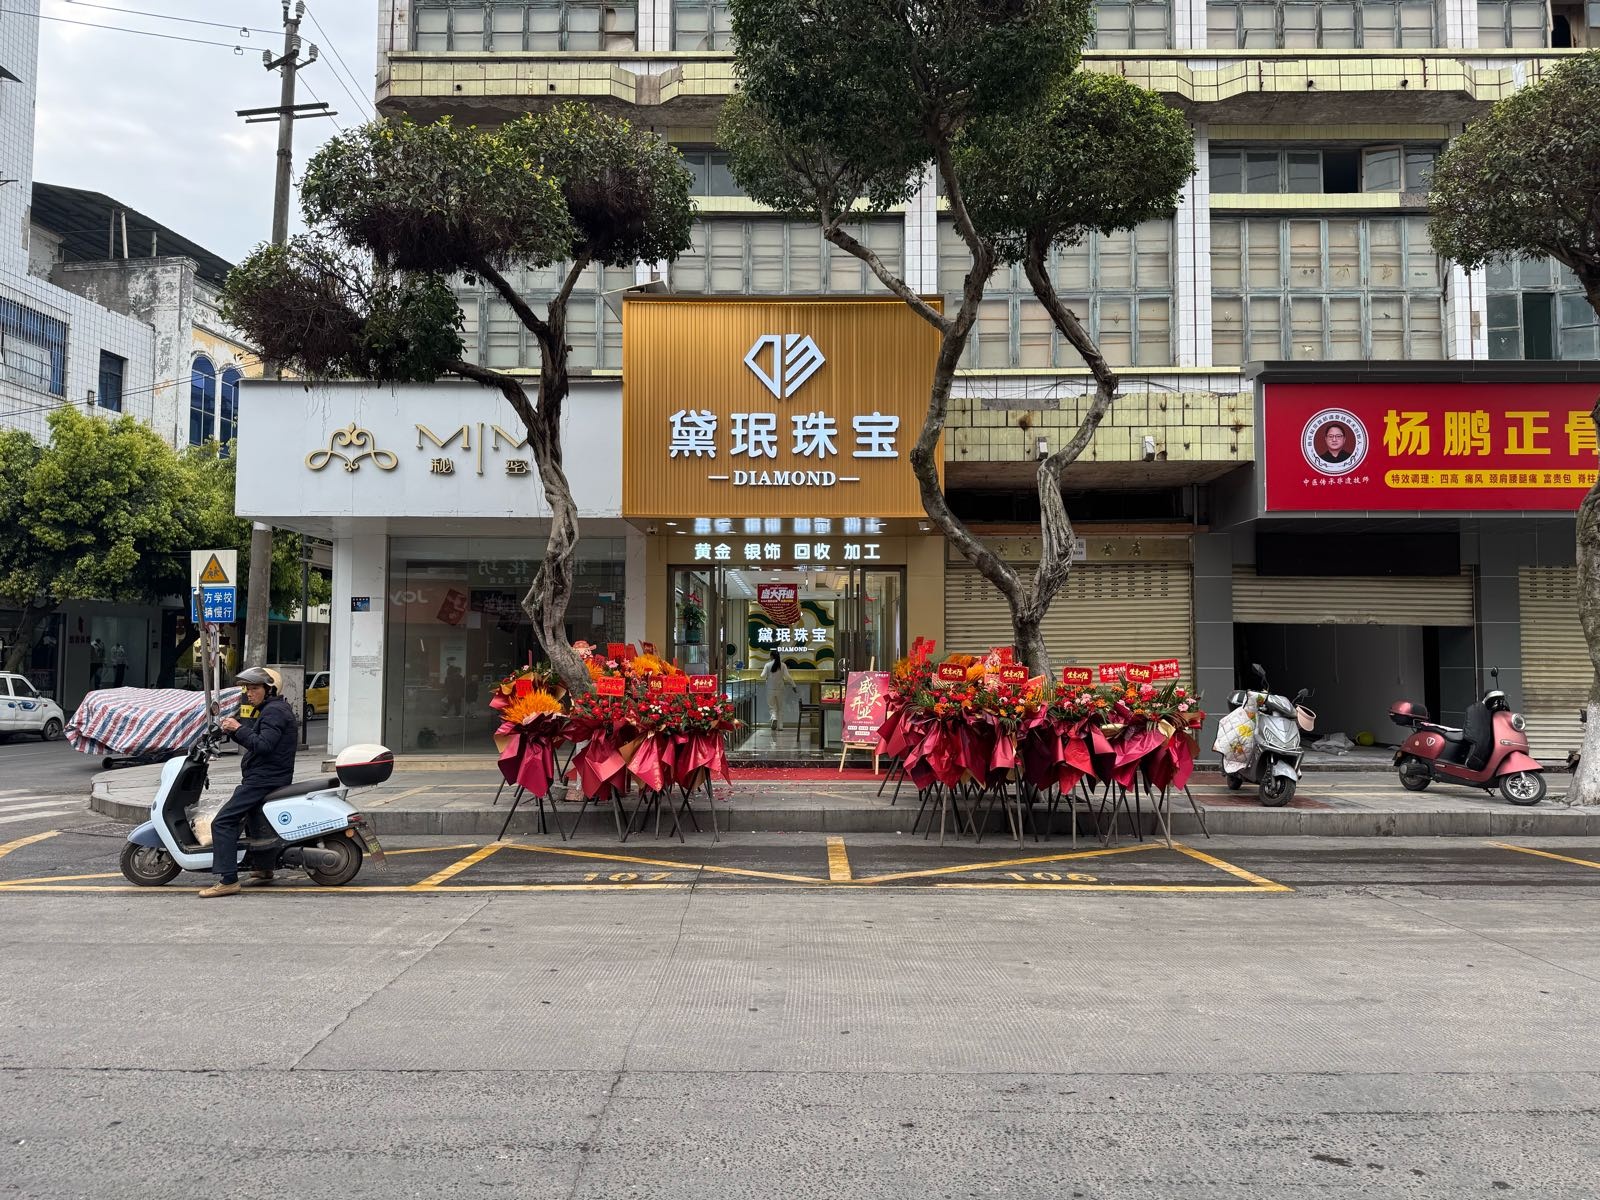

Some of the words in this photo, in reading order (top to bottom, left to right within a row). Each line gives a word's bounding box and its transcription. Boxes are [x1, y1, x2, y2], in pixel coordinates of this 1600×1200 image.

[669, 409, 900, 459] 黛珉珠宝
[1383, 409, 1599, 457] 杨鹏正骨
[733, 470, 836, 486] DIAMOND
[694, 543, 731, 560] 黄金
[744, 543, 781, 560] 银饰
[794, 543, 831, 560] 回收
[844, 543, 881, 560] 加工
[204, 592, 232, 604] 方学校
[758, 628, 827, 642] 黛珉珠宝
[1004, 871, 1098, 881] 106
